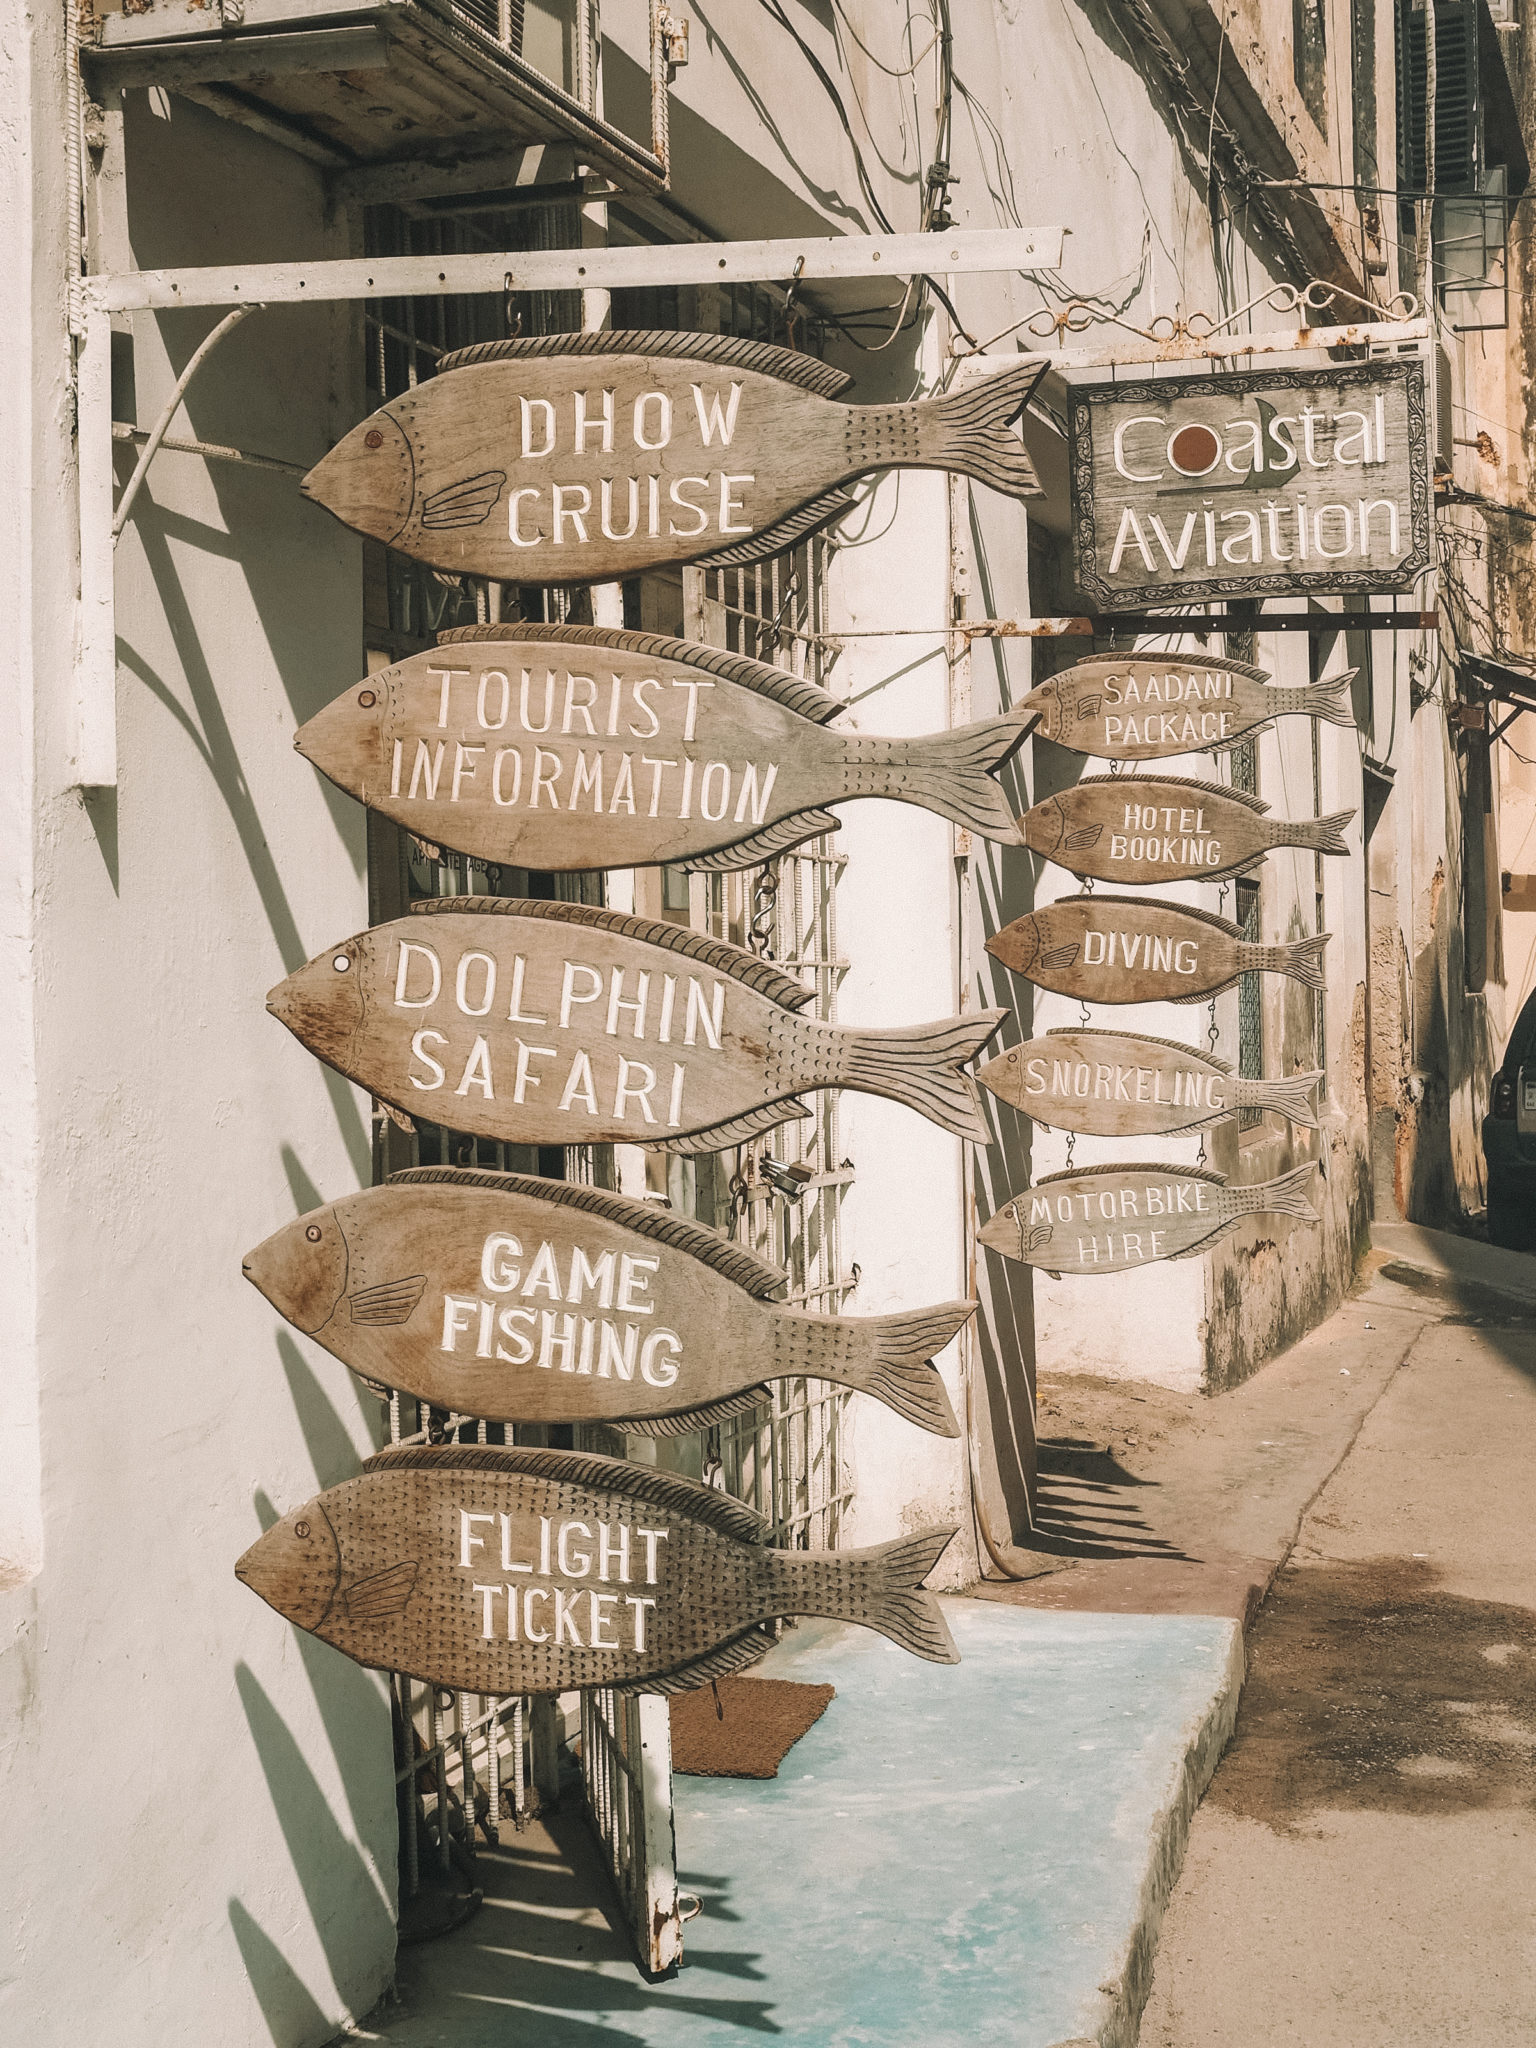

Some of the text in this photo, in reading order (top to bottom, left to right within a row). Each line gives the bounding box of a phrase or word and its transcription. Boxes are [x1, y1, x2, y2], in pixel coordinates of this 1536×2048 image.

[518, 379, 747, 459] DHOW
[1112, 391, 1387, 482] Coastal
[507, 470, 757, 548] CRUISE
[1107, 491, 1401, 575] Aviation
[426, 663, 716, 742] TOURIST
[1103, 671, 1234, 705] SAADANI
[1104, 711, 1235, 745] PACKAGE
[388, 736, 779, 825] INFORMATION
[1122, 802, 1212, 834] HOTEL
[1108, 834, 1222, 866] BOOKING
[1082, 929, 1200, 975] DIVING
[393, 937, 728, 1050] DOLPHIN
[407, 1028, 688, 1127] SAFARI
[1024, 1057, 1226, 1110] SNORKELING
[480, 1230, 661, 1315] GAME
[1076, 1230, 1168, 1265] HIRE
[439, 1293, 684, 1388] FISHING
[457, 1507, 670, 1584] FLIGHT
[471, 1580, 657, 1653] TICKET
